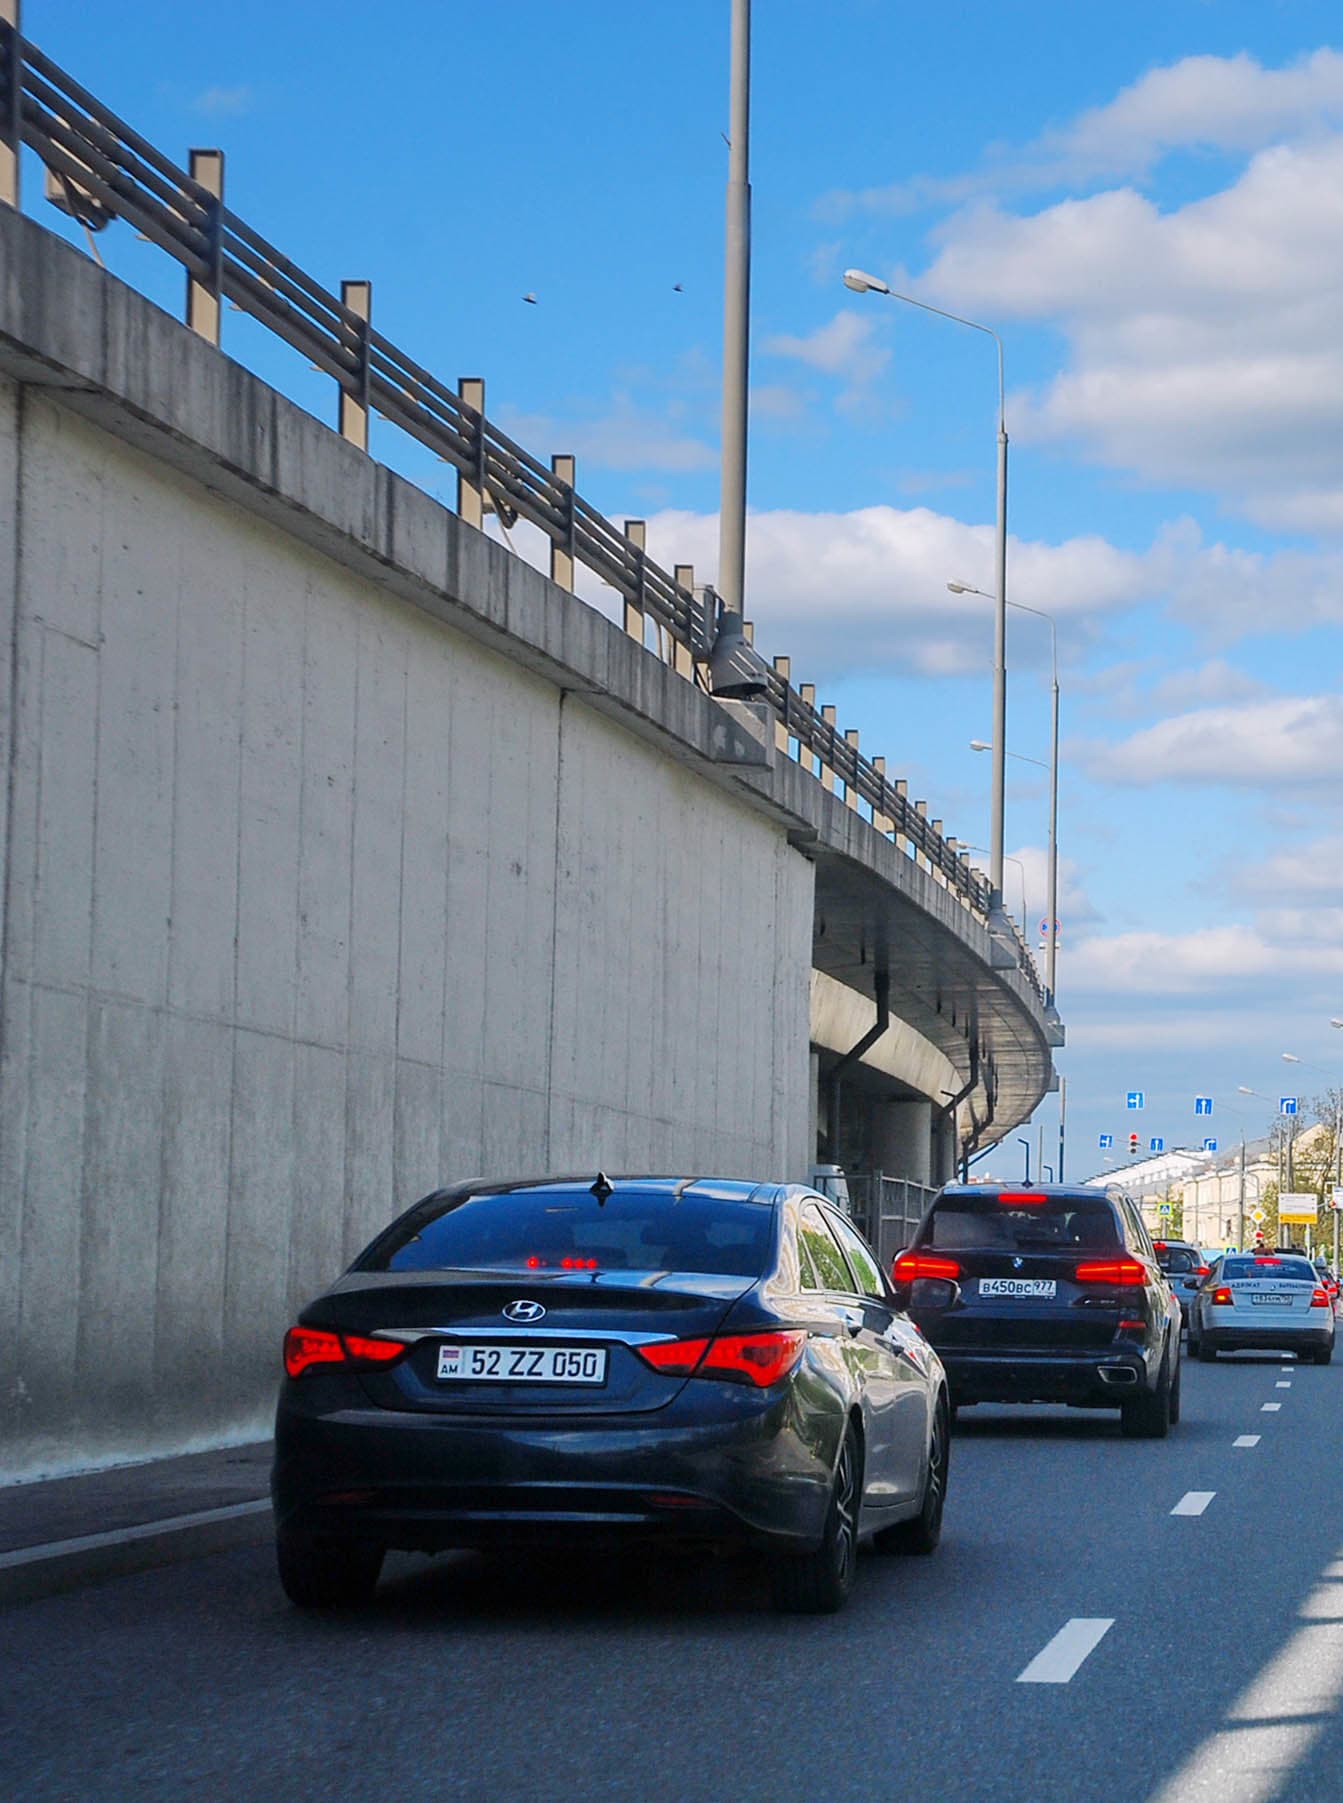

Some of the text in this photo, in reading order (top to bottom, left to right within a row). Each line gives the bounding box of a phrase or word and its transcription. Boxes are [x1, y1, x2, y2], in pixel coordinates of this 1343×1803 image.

[441, 1364, 458, 1375] AM
[472, 1350, 597, 1378] 52 ZZ 050
